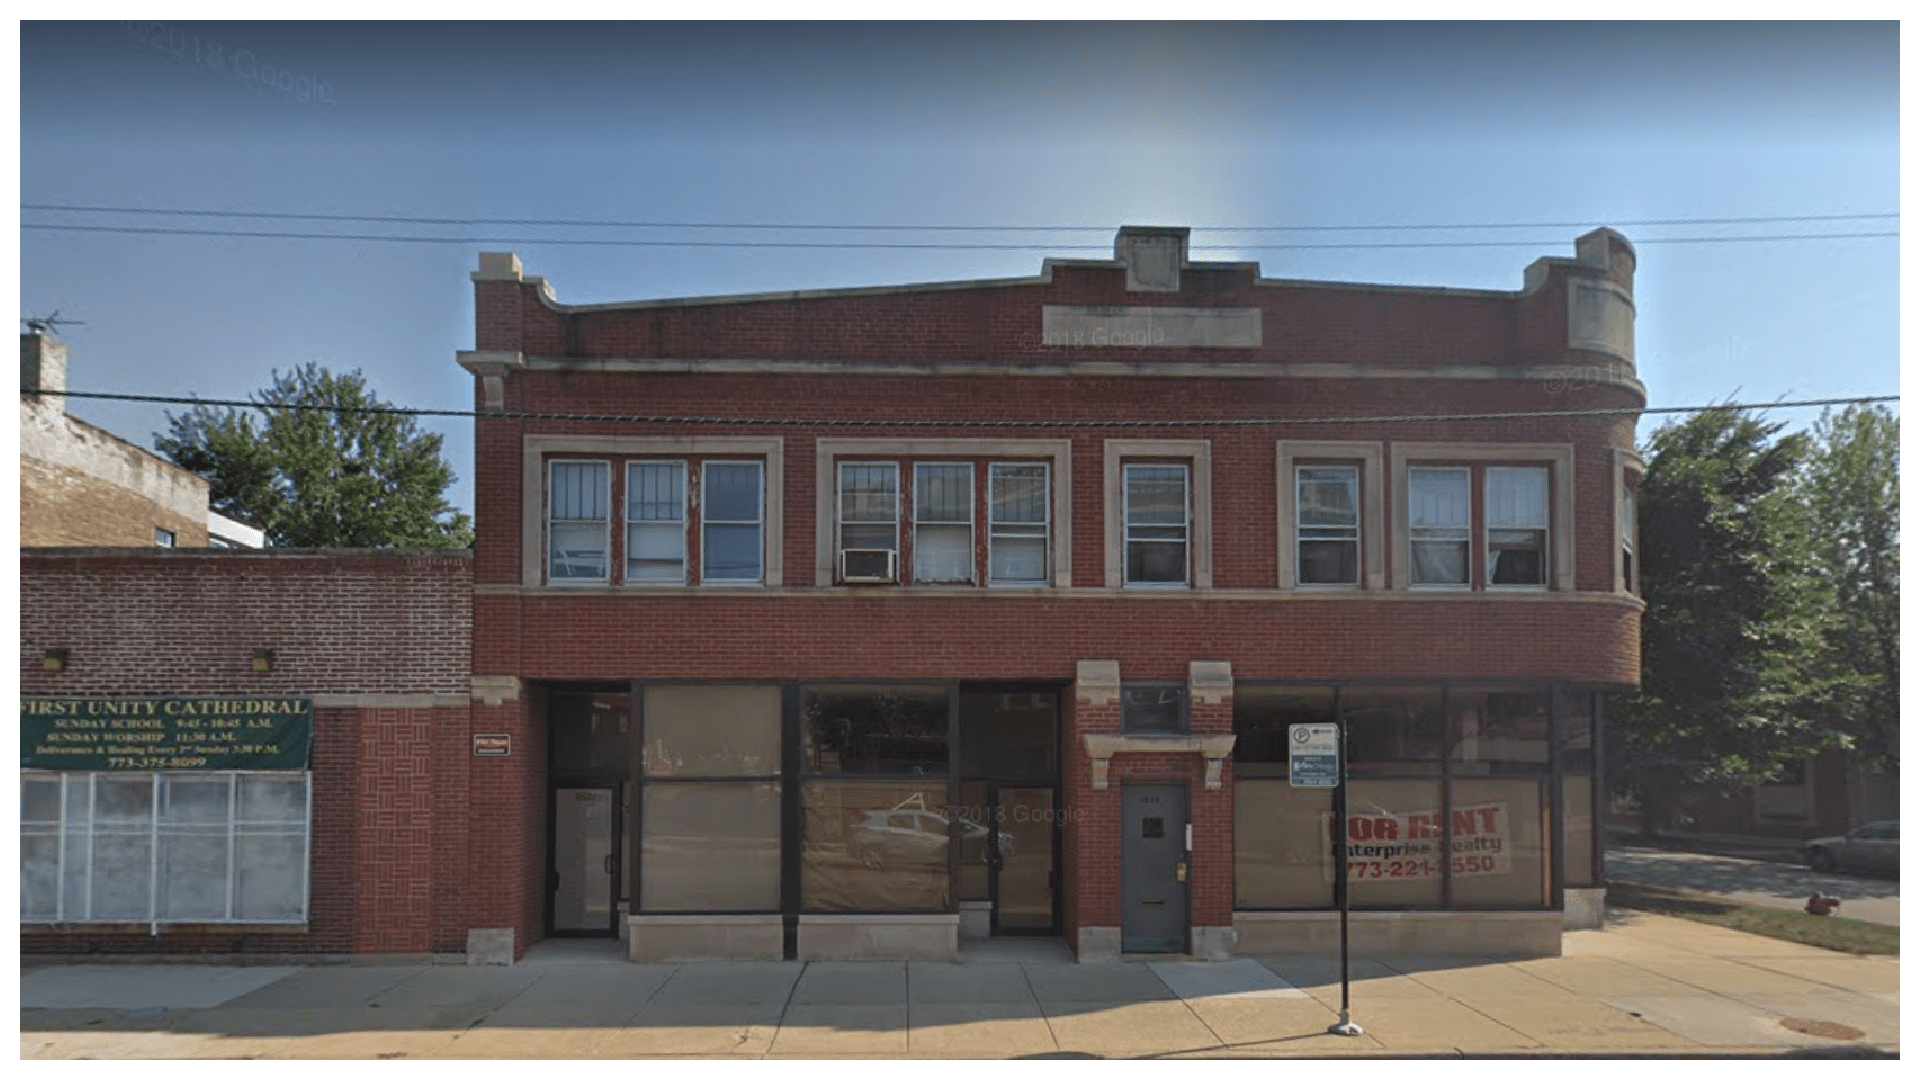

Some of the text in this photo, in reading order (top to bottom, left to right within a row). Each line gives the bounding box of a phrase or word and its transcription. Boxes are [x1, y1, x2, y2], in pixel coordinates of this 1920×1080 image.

[88, 700, 158, 715] UNITY
[164, 700, 308, 715] CATHEDRAL
[54, 719, 107, 729] SUNDAY
[110, 719, 165, 729] SCHOOL
[46, 732, 99, 742] SUNDAY
[103, 732, 166, 742] WORSHIP
[1331, 841, 1431, 859] nterprise
[1345, 855, 1495, 878] 73-221-550
